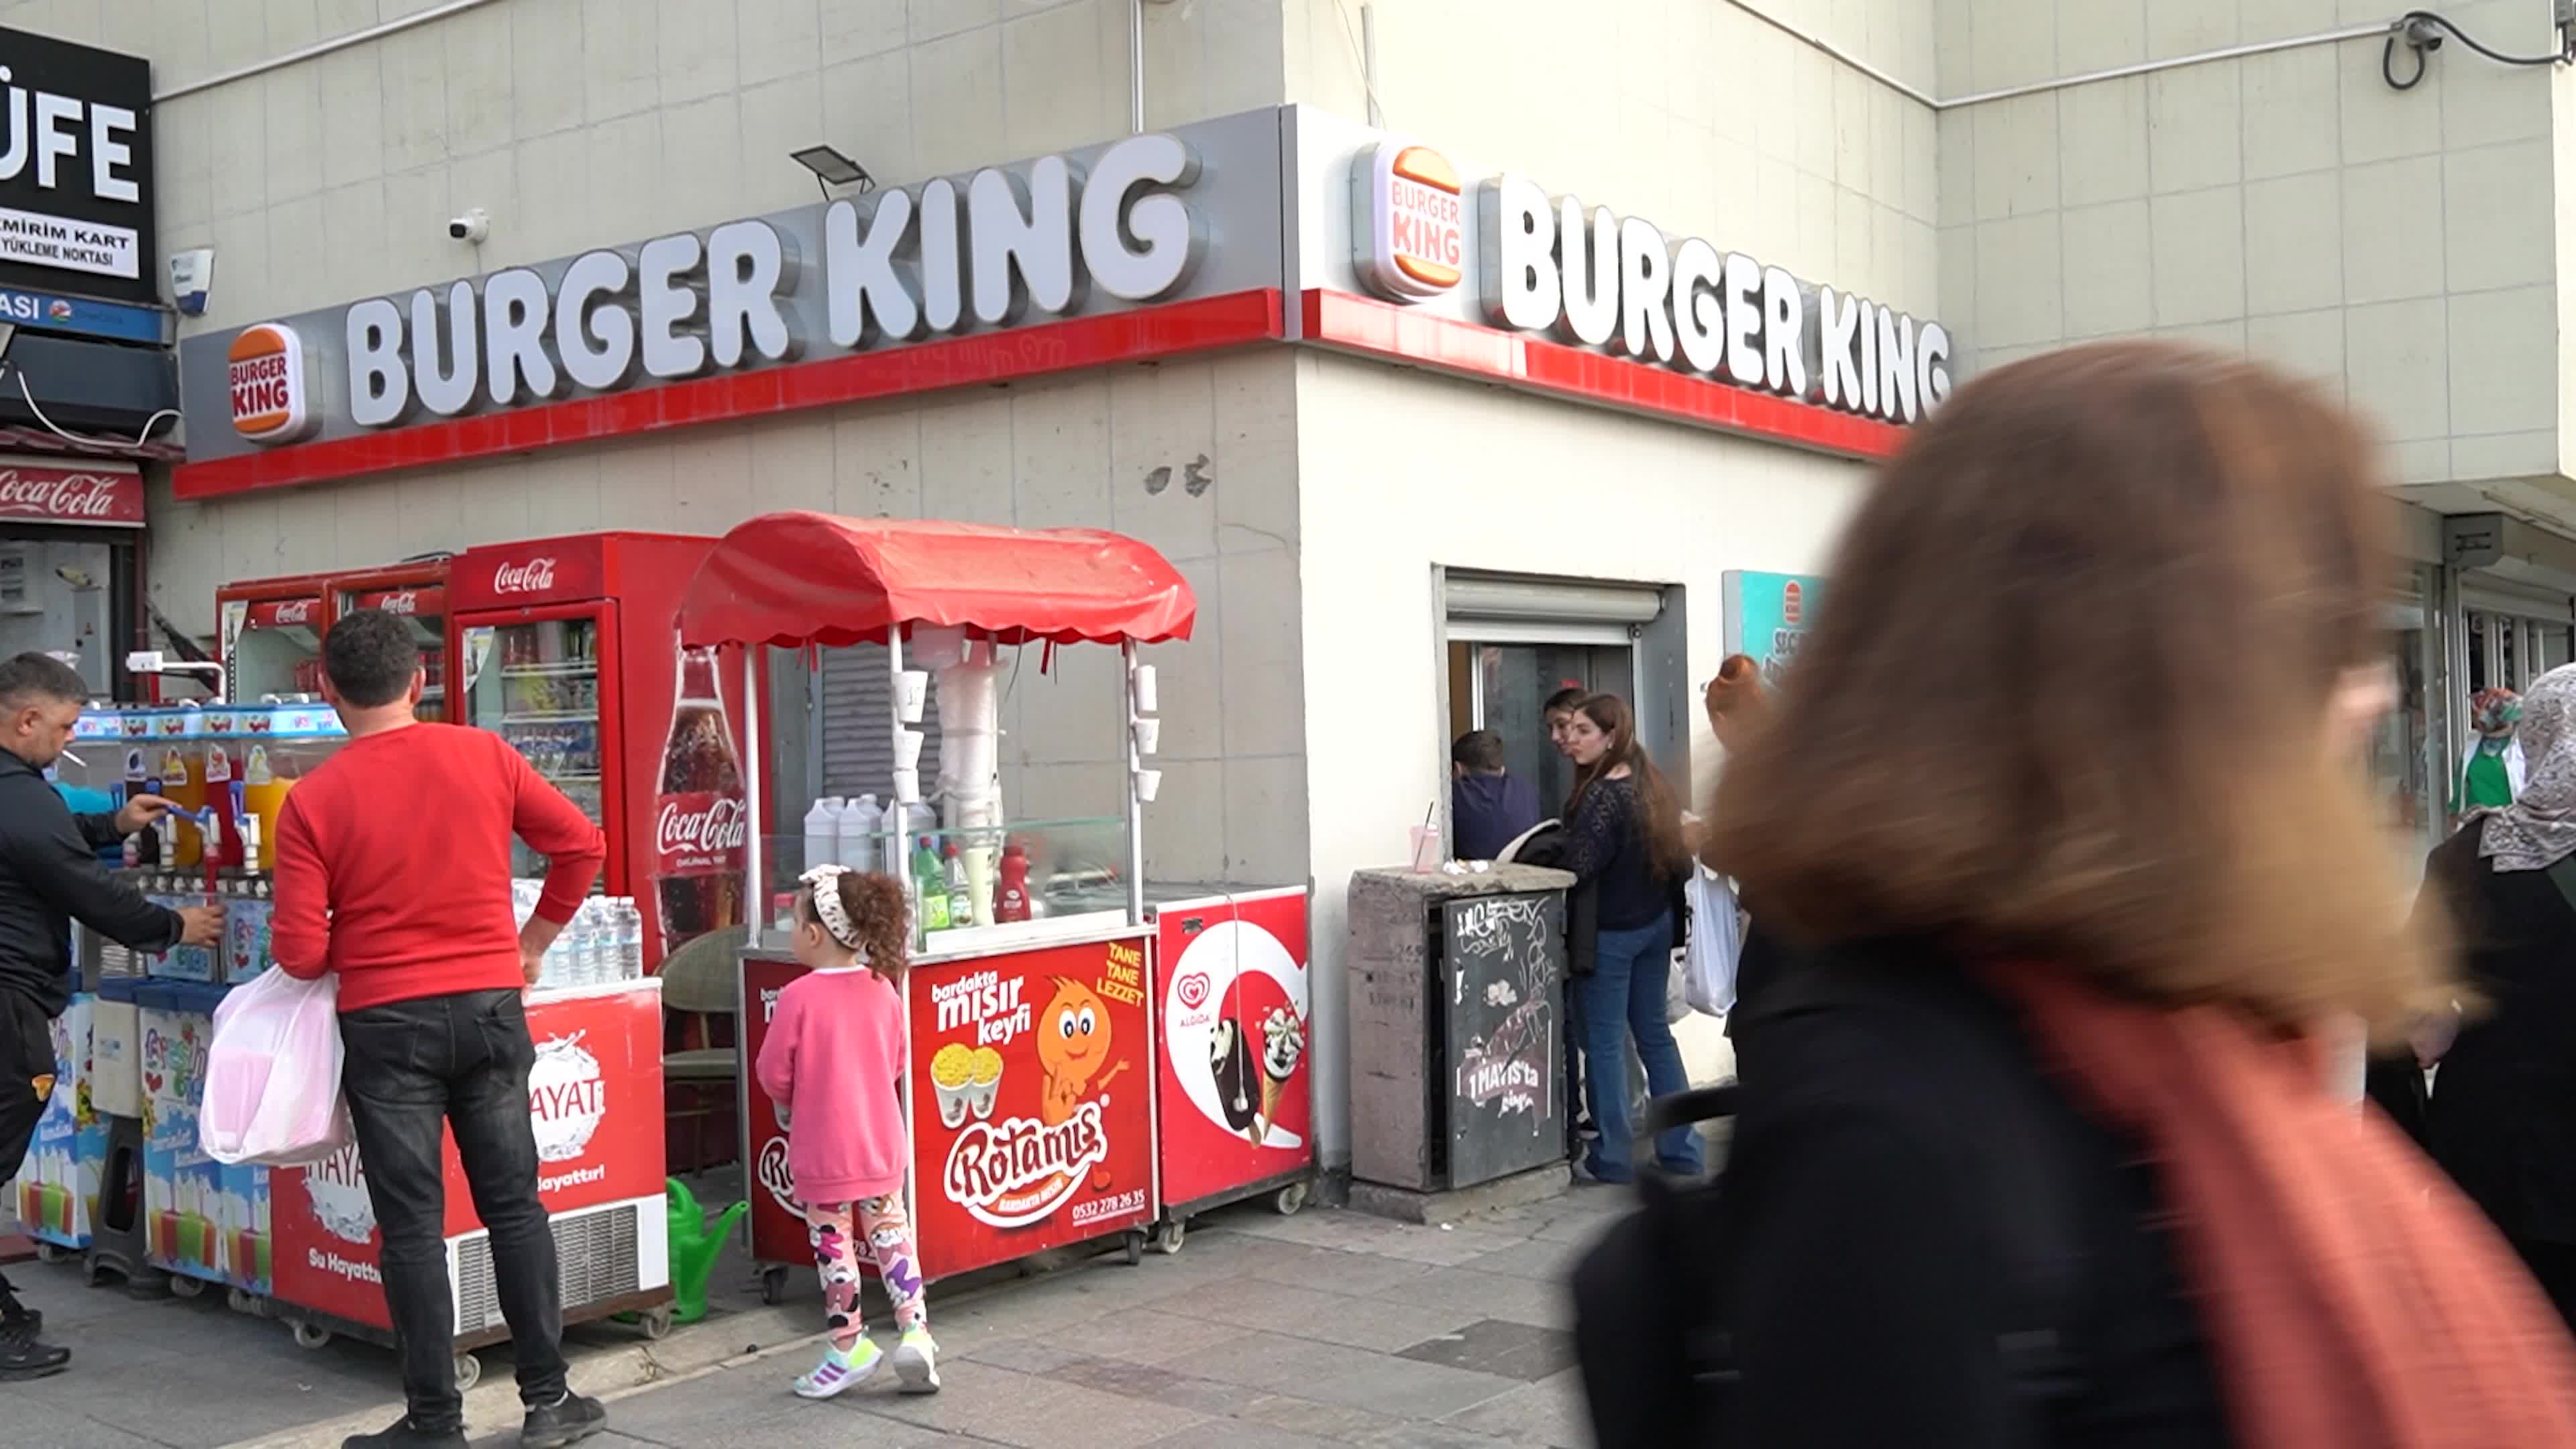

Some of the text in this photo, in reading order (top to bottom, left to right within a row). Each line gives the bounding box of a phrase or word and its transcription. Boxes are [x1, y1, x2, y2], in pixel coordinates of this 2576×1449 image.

[1393, 180, 1460, 226] BURGER
[0, 219, 129, 250] MİRİM KART
[1393, 211, 1460, 265] KING
[2, 237, 113, 266] YÜKLEME NOKTASI
[346, 133, 1191, 427] BURGER KING
[1500, 172, 1951, 424] BURGER KING
[231, 356, 286, 386] BURGER
[232, 378, 288, 417] KING
[1109, 942, 1142, 968] TANE
[932, 971, 998, 1003] bardakta
[1106, 960, 1138, 987] TANE
[1096, 977, 1144, 1007] LEZZET
[977, 1003, 1030, 1046] keyfi
[1180, 1014, 1211, 1027] ALGIDA
[1073, 1188, 1144, 1220] 0532 278 26 35
[309, 1248, 326, 1269] Su
